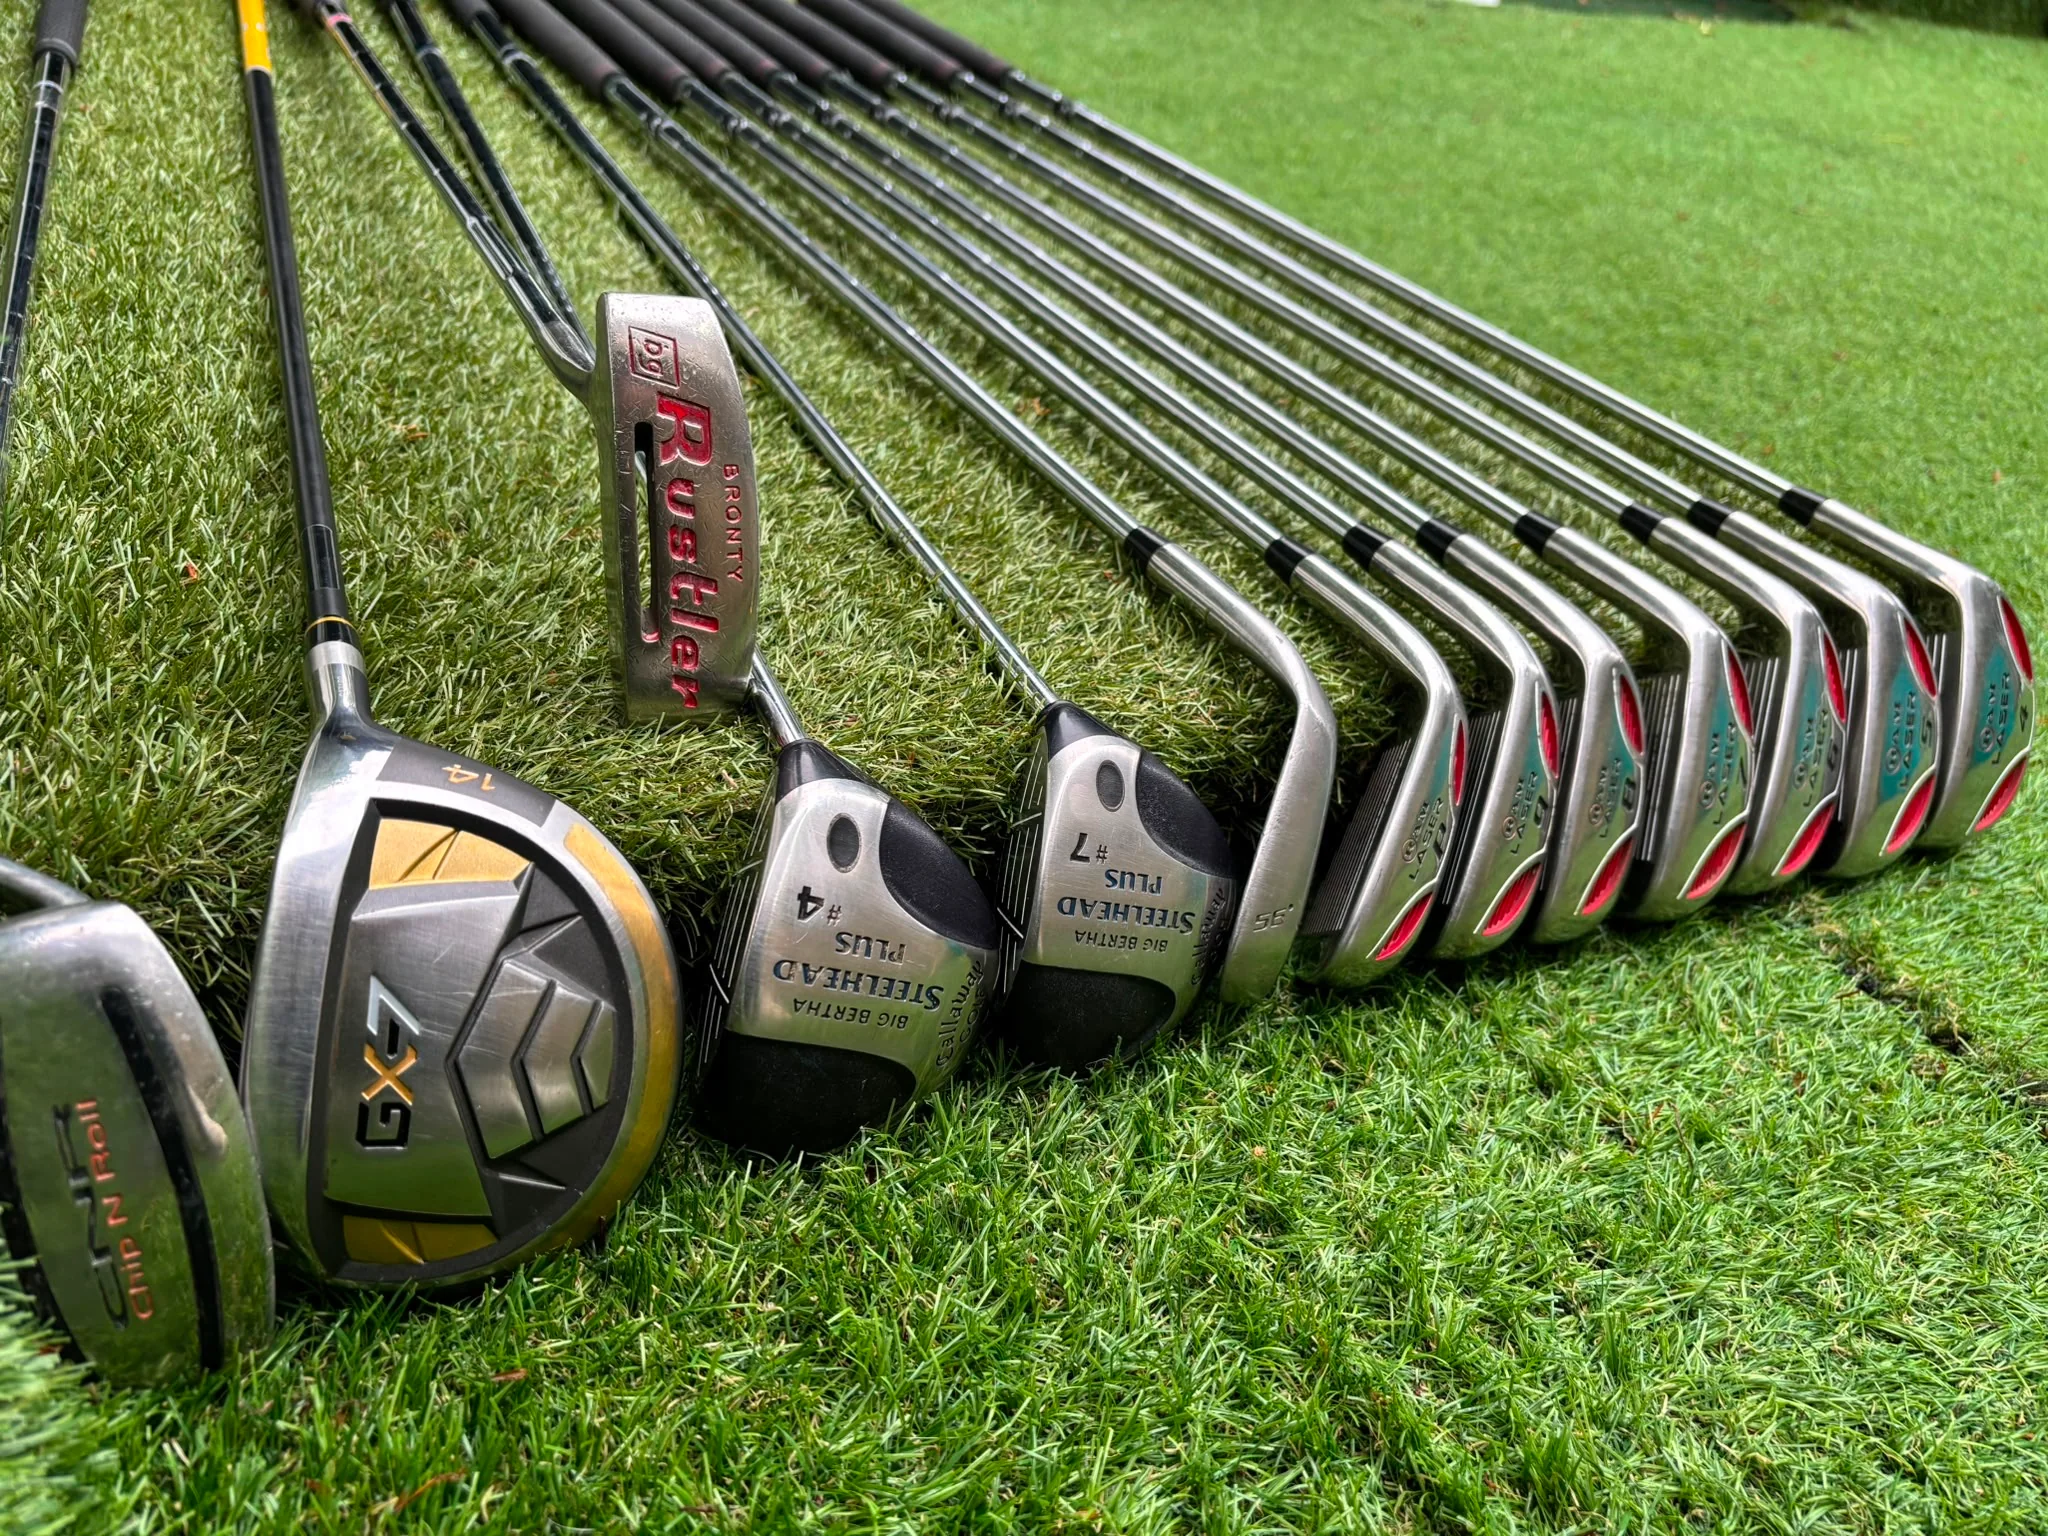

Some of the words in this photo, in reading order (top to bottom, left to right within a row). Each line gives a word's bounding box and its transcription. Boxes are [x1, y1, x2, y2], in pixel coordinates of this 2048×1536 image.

[656, 391, 720, 709] Rustler
[722, 463, 744, 583] BRONTY
[1712, 721, 1738, 825] LASER
[1900, 690, 1917, 789] LASER
[442, 763, 497, 791] 14
[1408, 797, 1444, 881] LASER
[1510, 771, 1540, 855] LASER
[1057, 896, 1196, 935] STEELHEAD
[1105, 869, 1163, 896] PLUS
[835, 931, 906, 964] PLUS
[1075, 929, 1138, 950] BERTHA
[1142, 938, 1168, 953] BIG
[773, 959, 944, 1011] STEELHEAD
[793, 998, 871, 1026] BERTHA
[936, 959, 985, 1069] Callaway
[877, 1012, 909, 1030] BIG
[356, 975, 422, 1150] GX-7
[76, 1099, 115, 1182] Roll
[102, 1194, 127, 1228] N
[119, 1236, 153, 1320] Chip
